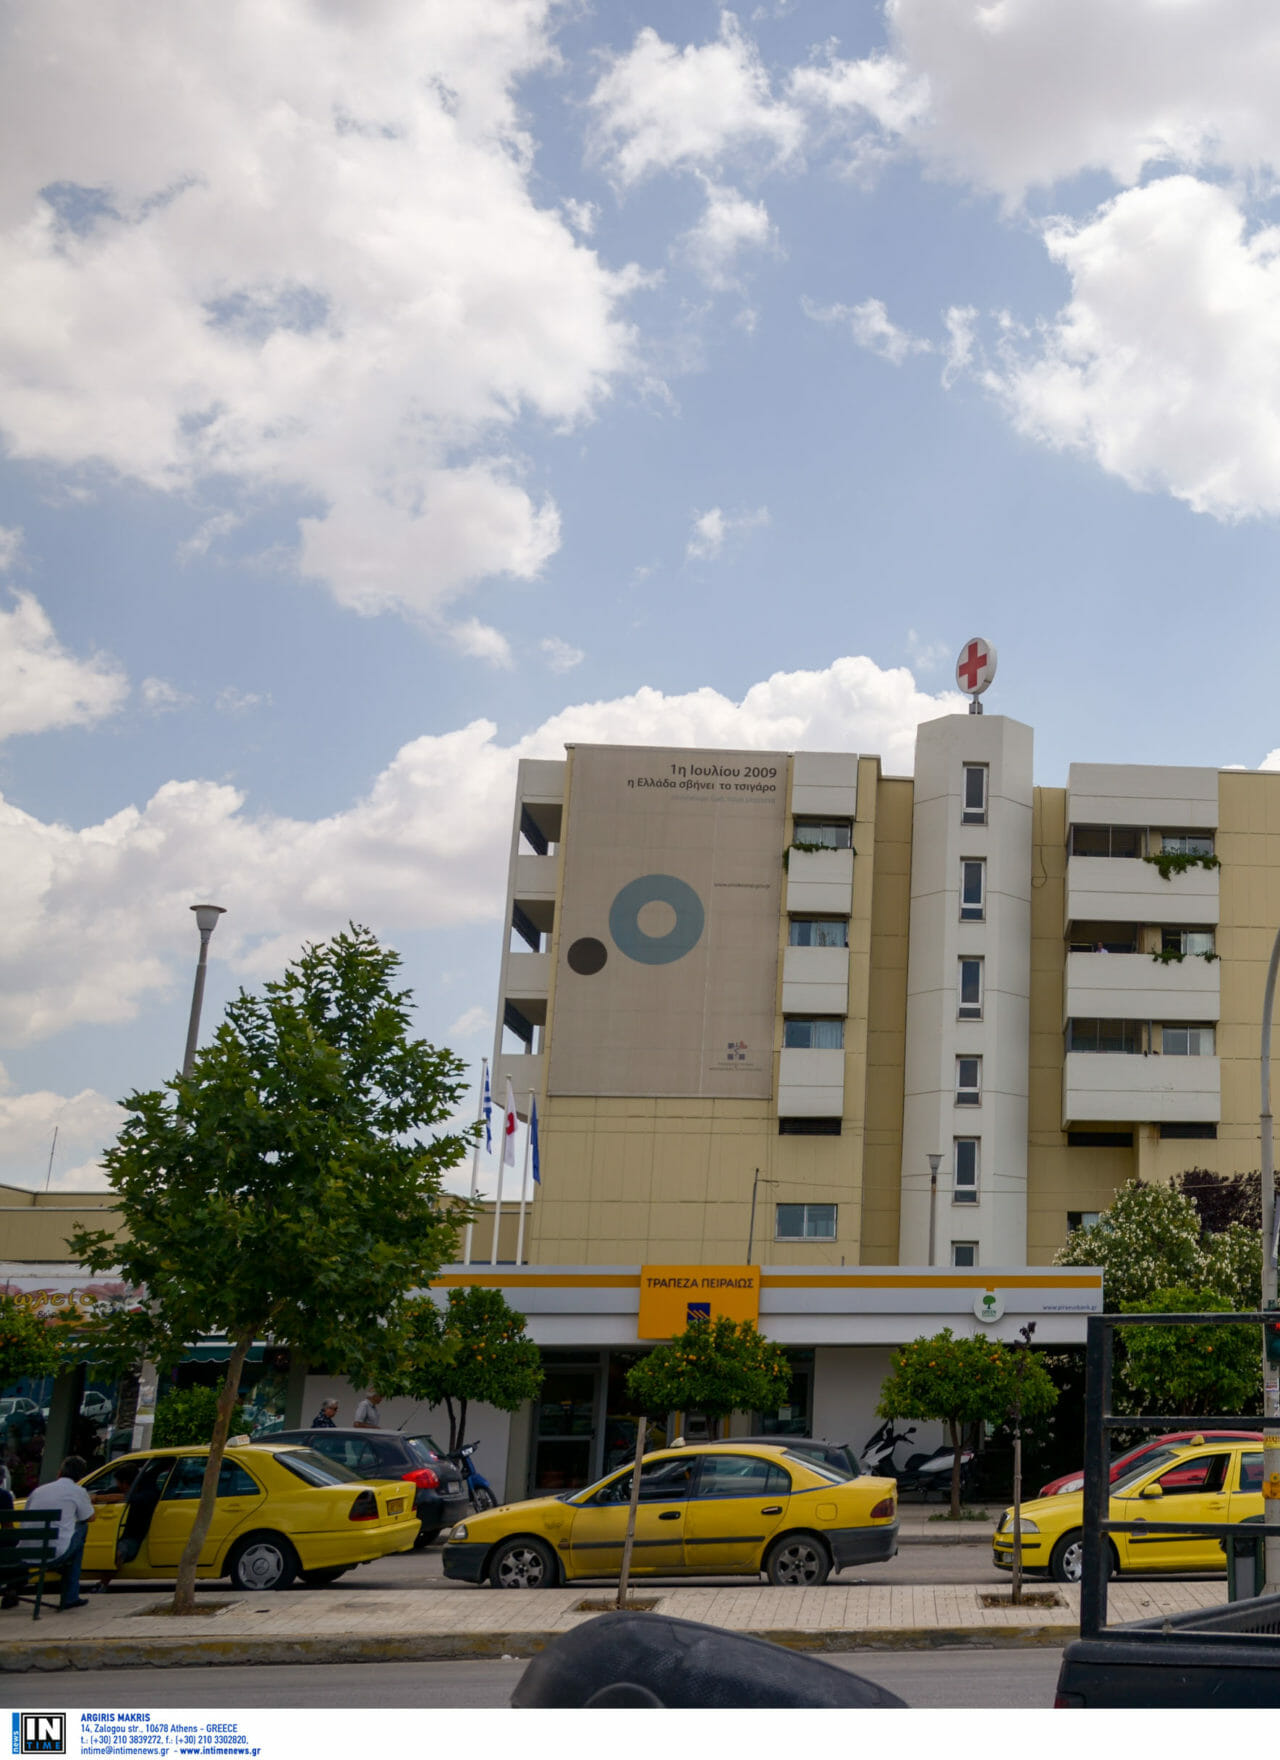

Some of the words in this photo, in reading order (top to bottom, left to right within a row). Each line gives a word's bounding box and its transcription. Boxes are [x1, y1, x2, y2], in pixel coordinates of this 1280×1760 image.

[671, 764, 687, 777] 1η
[690, 765, 741, 777] Ιουλίου
[744, 766, 777, 778] 2009
[627, 779, 635, 788] η
[637, 778, 676, 788] Ελλάδα
[679, 779, 715, 791] σβήνει
[735, 782, 776, 792] τσιγάρο
[647, 1278, 698, 1288] ΤΡΑΠΕΖΑ
[701, 1278, 754, 1288] ΠΕΙΡΑΙΩΣ
